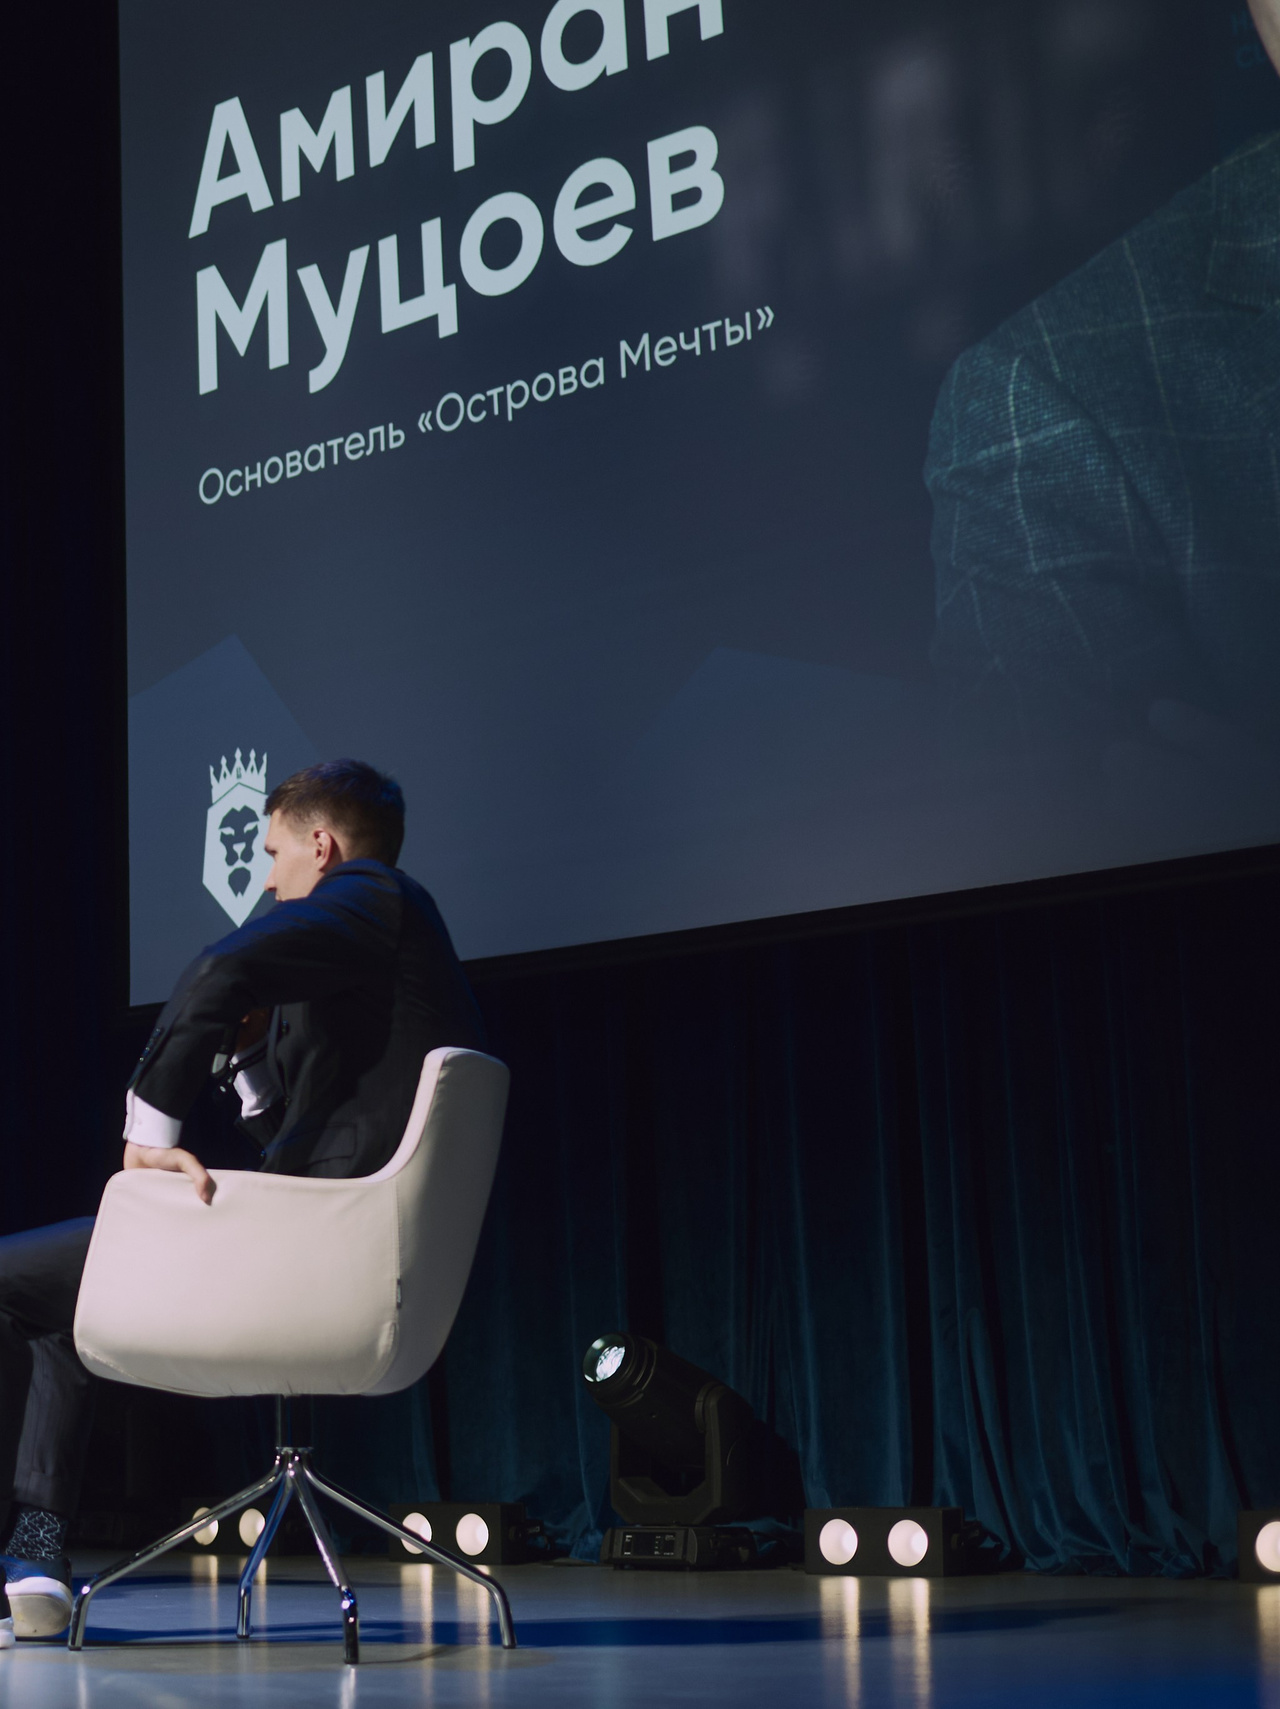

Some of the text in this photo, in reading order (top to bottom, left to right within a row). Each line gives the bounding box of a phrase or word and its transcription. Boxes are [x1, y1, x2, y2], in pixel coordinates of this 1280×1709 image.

[196, 125, 725, 396] Муцоев
[198, 305, 775, 505] Основатель «Острова Мечты»
